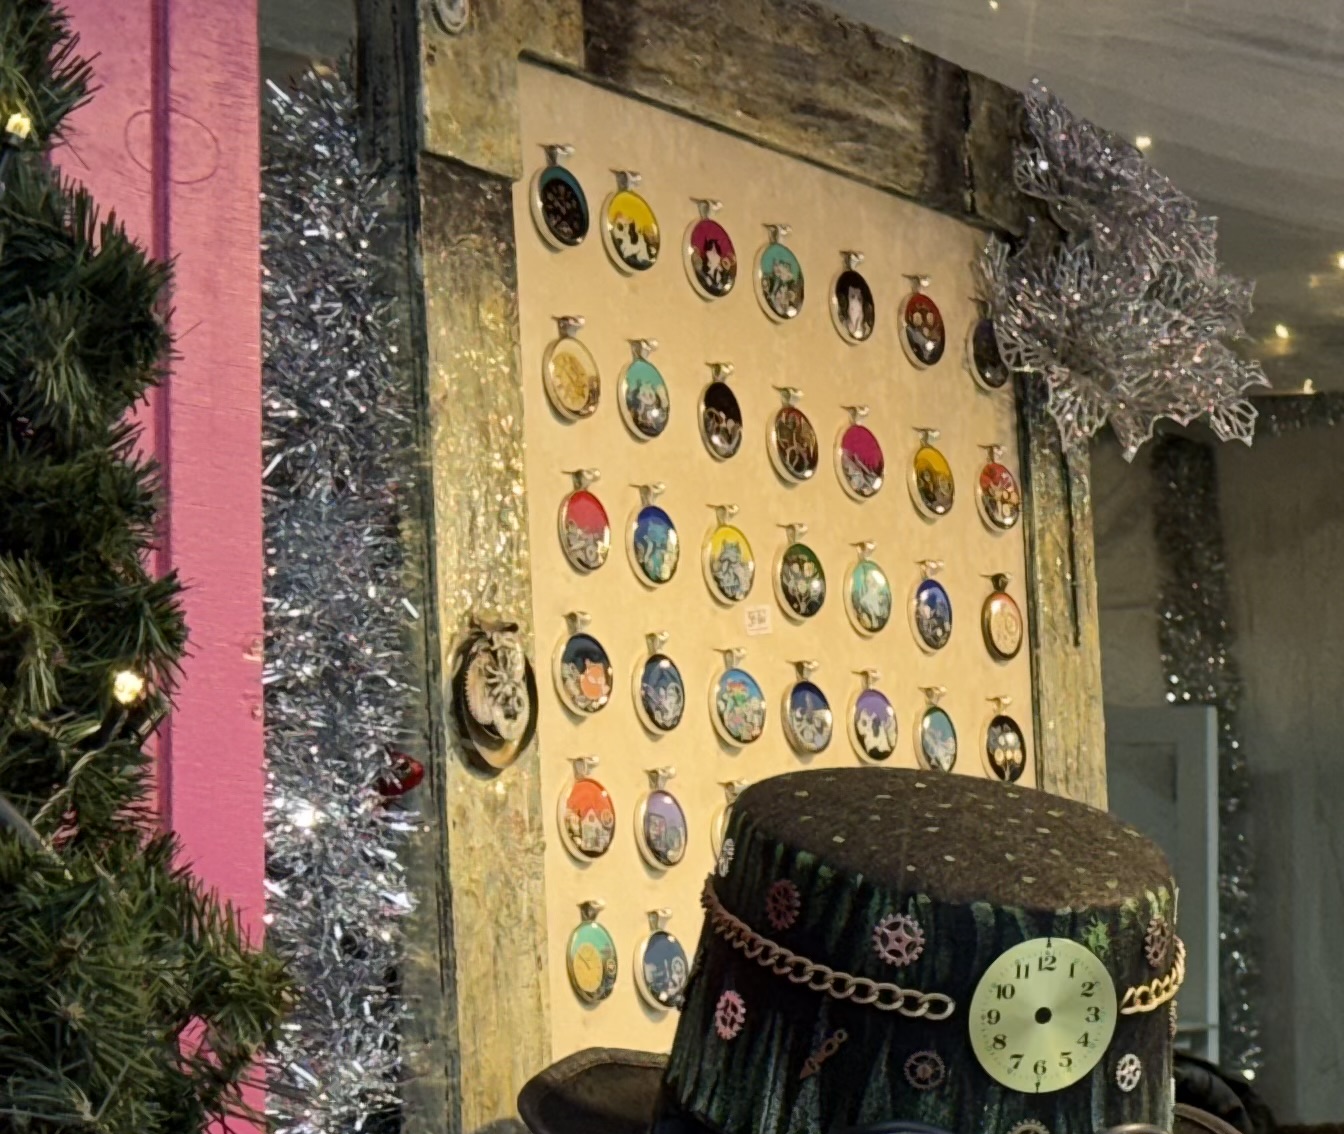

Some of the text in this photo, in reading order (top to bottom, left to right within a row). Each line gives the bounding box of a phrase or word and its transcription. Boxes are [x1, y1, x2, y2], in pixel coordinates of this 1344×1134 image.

[1015, 962, 1030, 980] 11
[1037, 955, 1057, 972] 12
[1068, 962, 1076, 979] 1
[996, 983, 1016, 1000] 10
[1080, 981, 1096, 998] 2
[987, 1009, 1001, 1025] 9
[1085, 1006, 1100, 1023] 3
[992, 1034, 1007, 1050] 8
[1077, 1031, 1090, 1047] 4
[1010, 1053, 1025, 1070] 7
[1033, 1059, 1048, 1076] 6
[1059, 1051, 1073, 1068] 5
